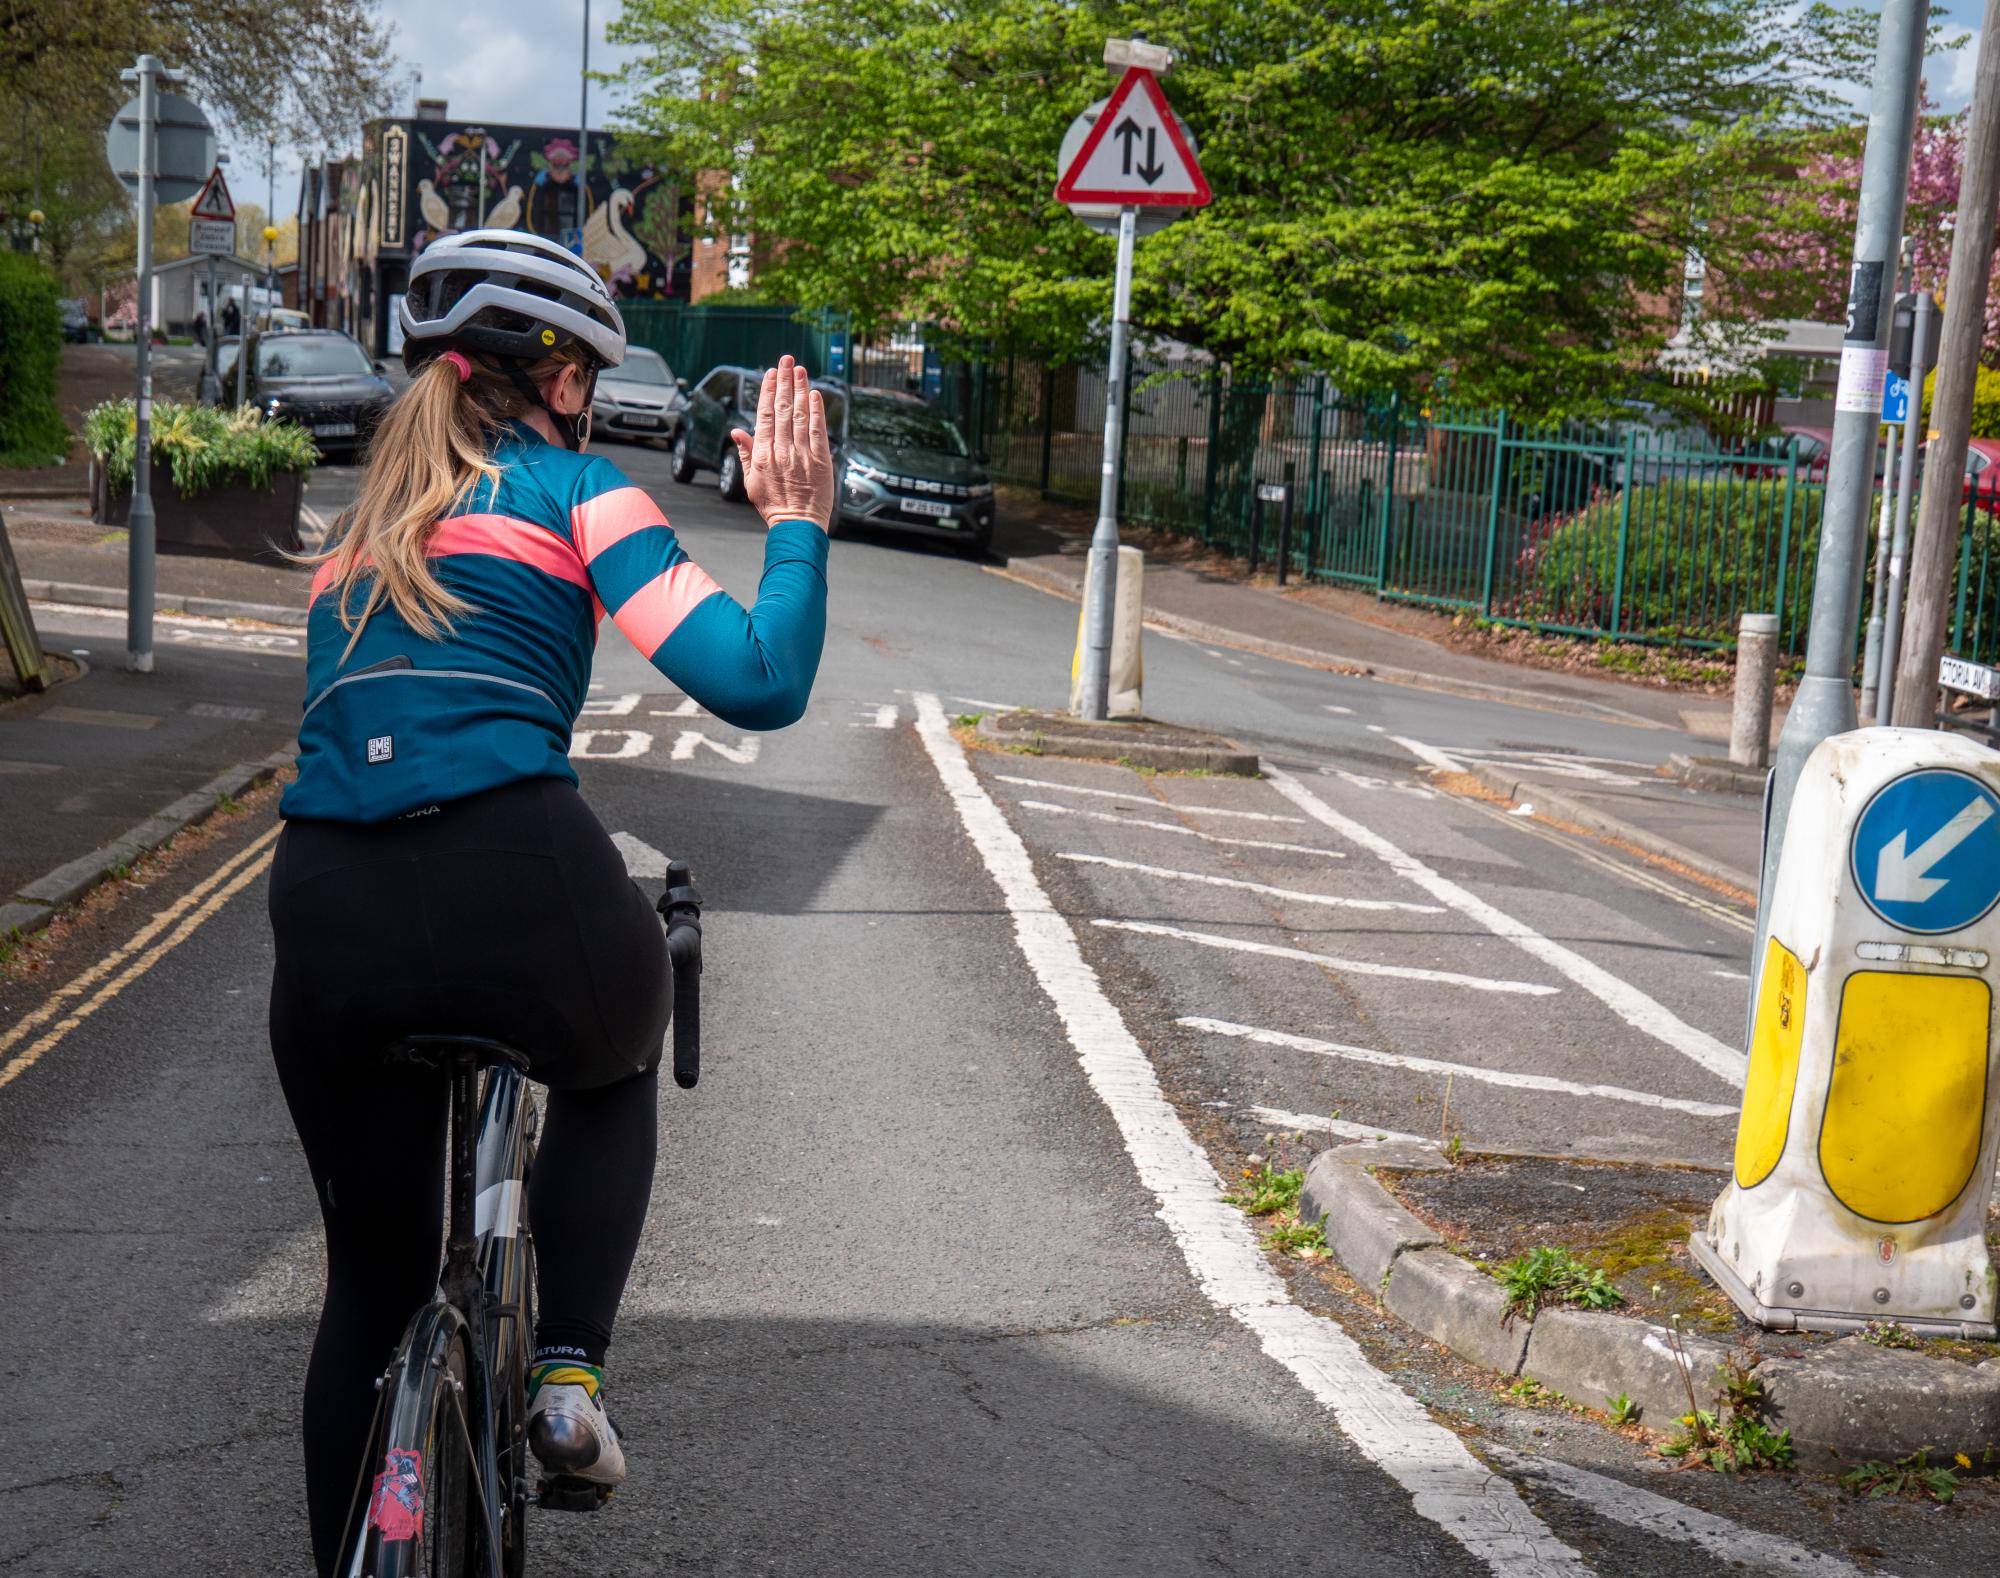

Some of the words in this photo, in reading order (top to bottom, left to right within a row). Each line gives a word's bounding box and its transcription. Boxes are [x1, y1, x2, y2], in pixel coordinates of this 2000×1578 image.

[387, 138, 402, 241] SWANNERY
[370, 737, 390, 756] SMS
[536, 1345, 587, 1357] ALTURA
